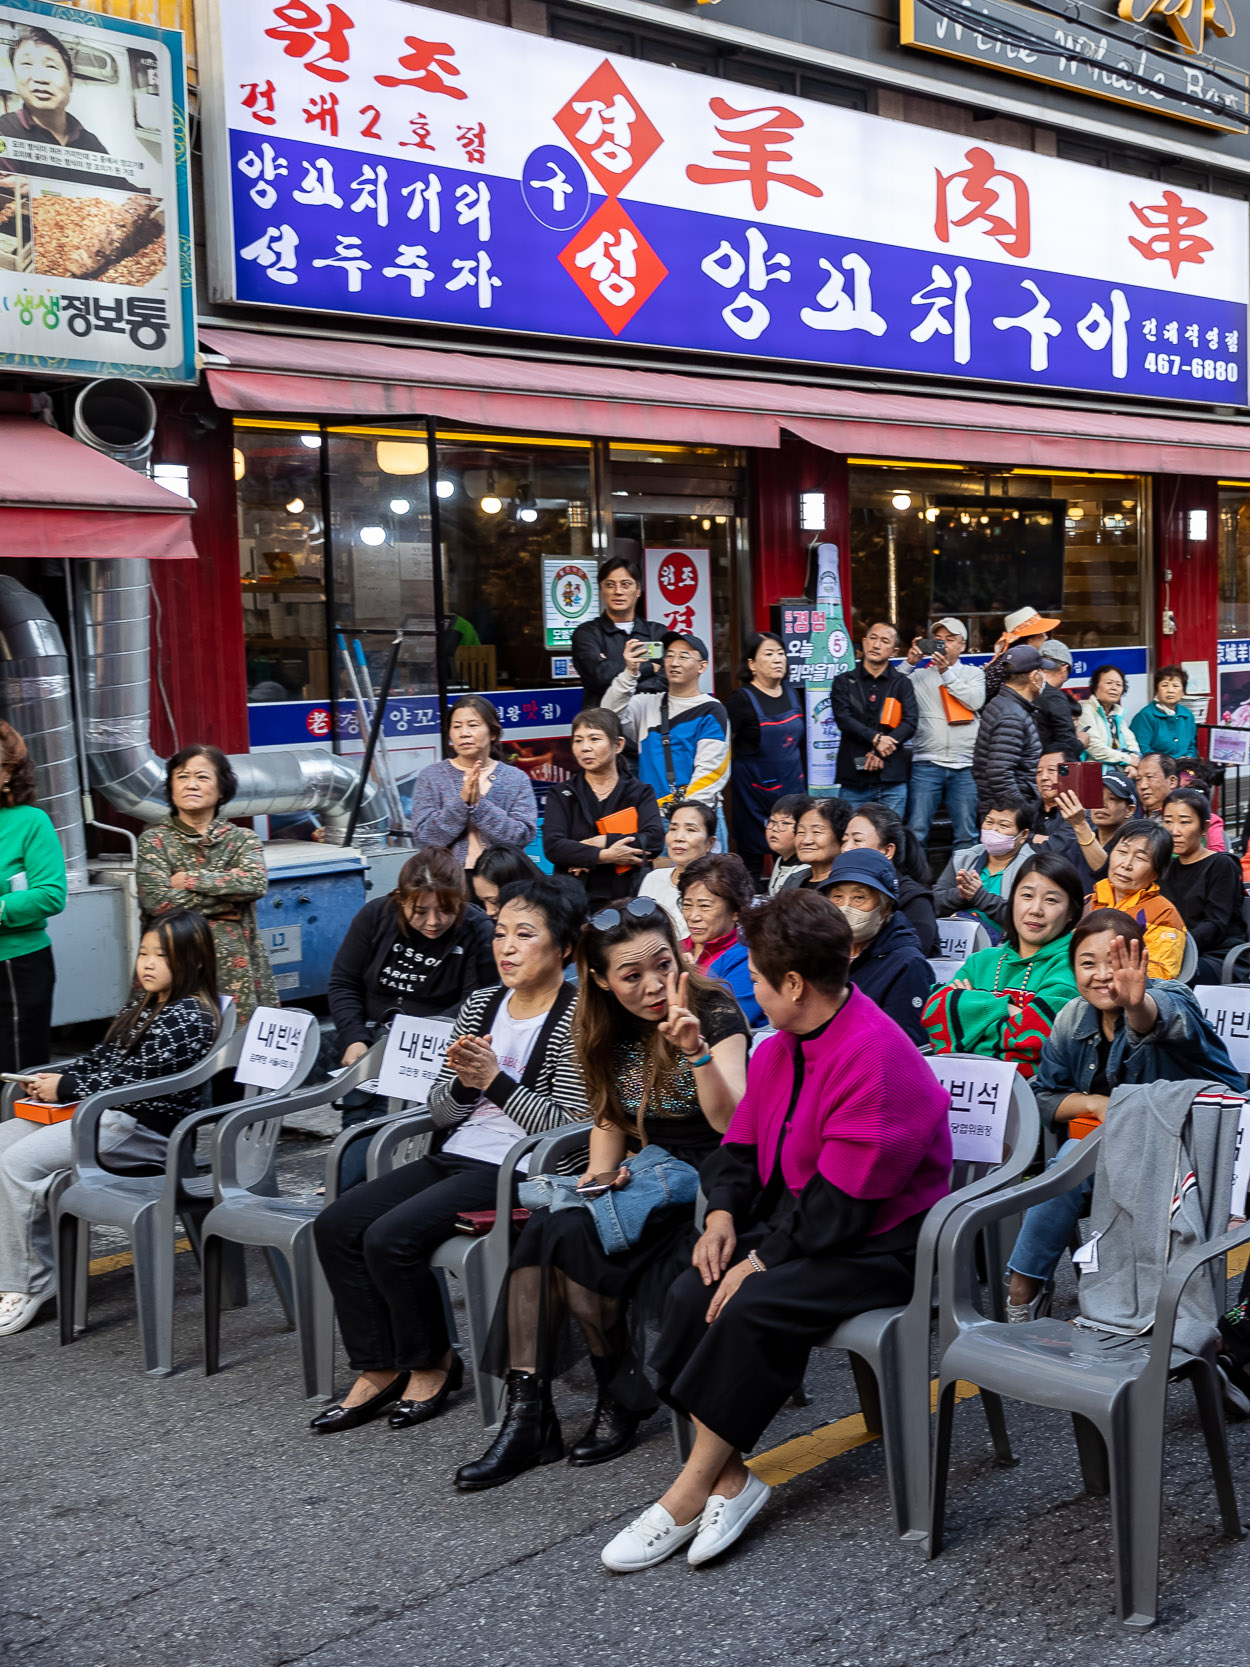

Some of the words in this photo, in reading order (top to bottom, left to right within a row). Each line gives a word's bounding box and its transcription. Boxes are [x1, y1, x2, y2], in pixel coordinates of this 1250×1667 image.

[264, 0, 468, 100] 원조
[240, 79, 486, 164] 건대2호점
[238, 143, 491, 242] 양꼬치거리
[529, 161, 574, 212] 구
[685, 97, 1215, 280] 羊肉串
[240, 224, 502, 309] 선두주자
[13, 289, 170, 350] 생생정보통
[700, 226, 1131, 379] 양꼬치구이
[1144, 352, 1239, 383] 467-6880
[660, 564, 696, 590] 원조
[786, 640, 814, 658] 오늘
[308, 711, 331, 735] 老
[389, 706, 441, 730] 양꼬
